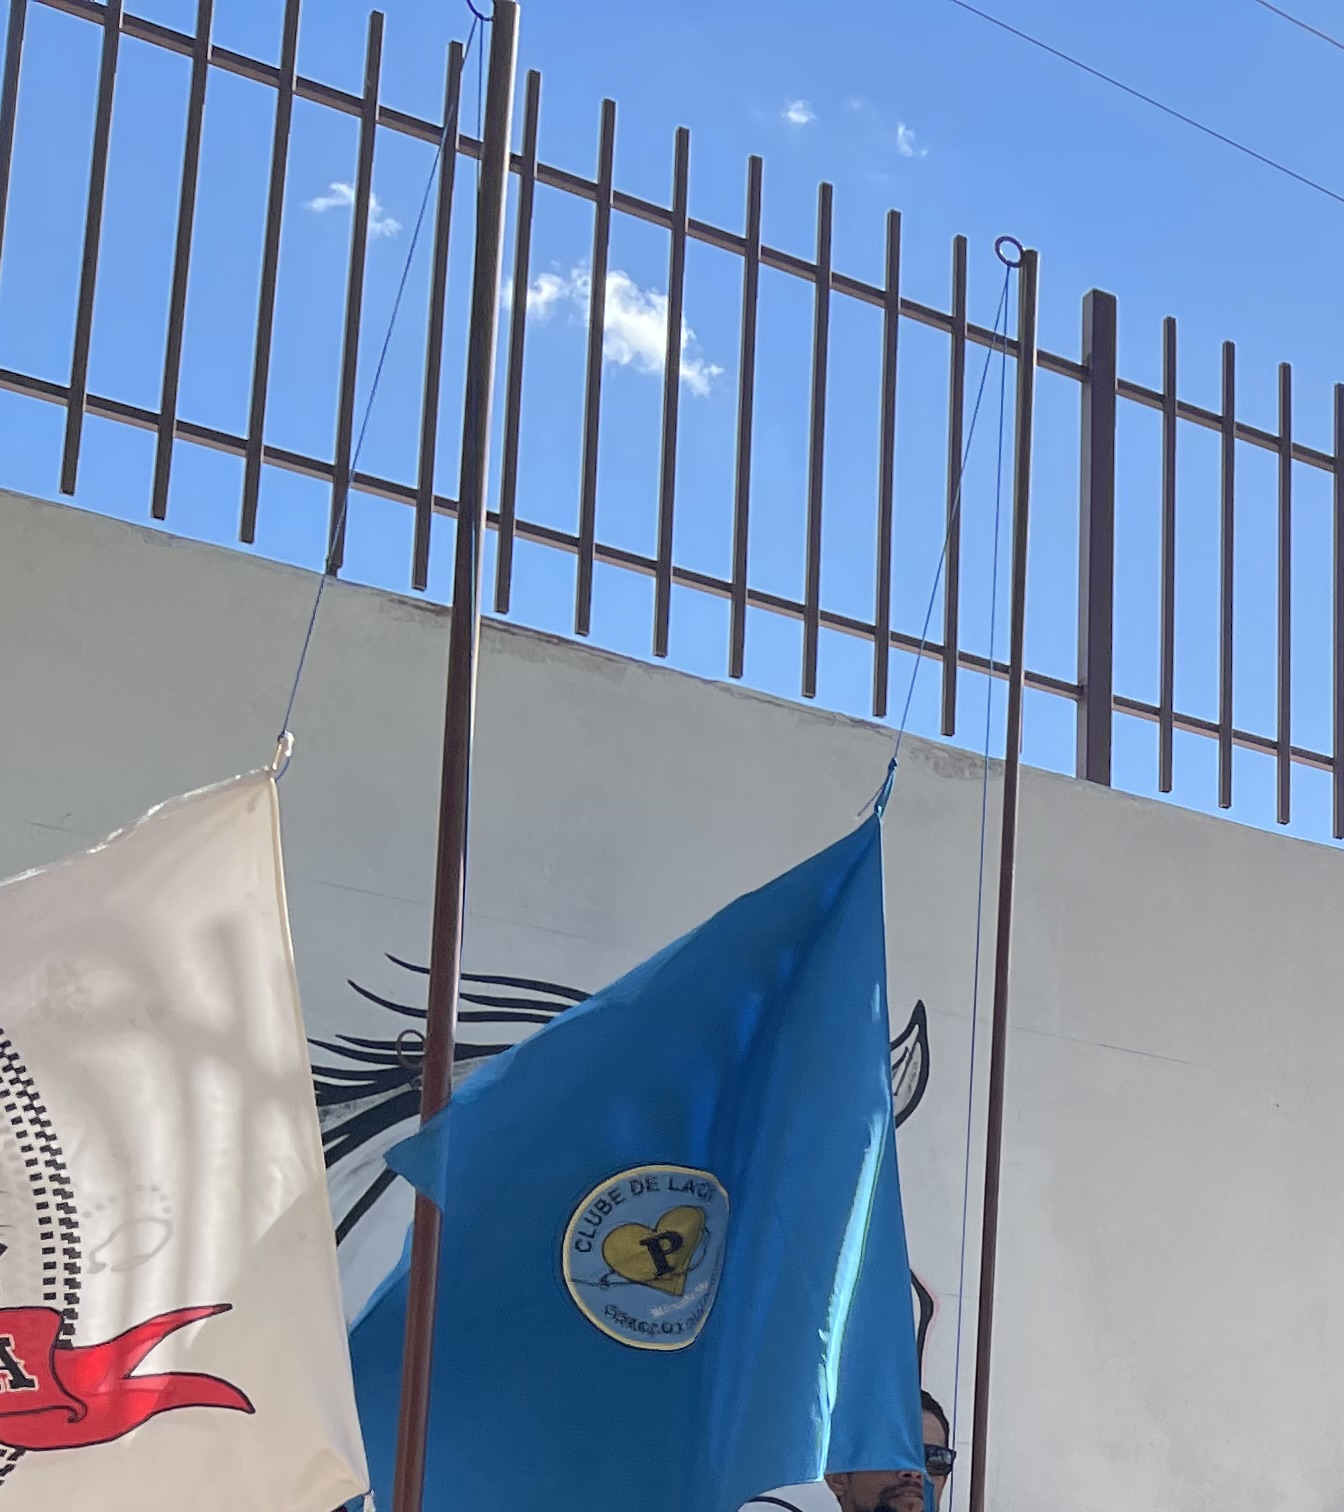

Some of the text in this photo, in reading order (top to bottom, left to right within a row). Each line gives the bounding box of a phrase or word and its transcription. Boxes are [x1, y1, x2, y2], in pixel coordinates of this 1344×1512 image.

[574, 1187, 626, 1254] CLUBE
[629, 1176, 660, 1196] DE
[639, 1230, 684, 1277] P
